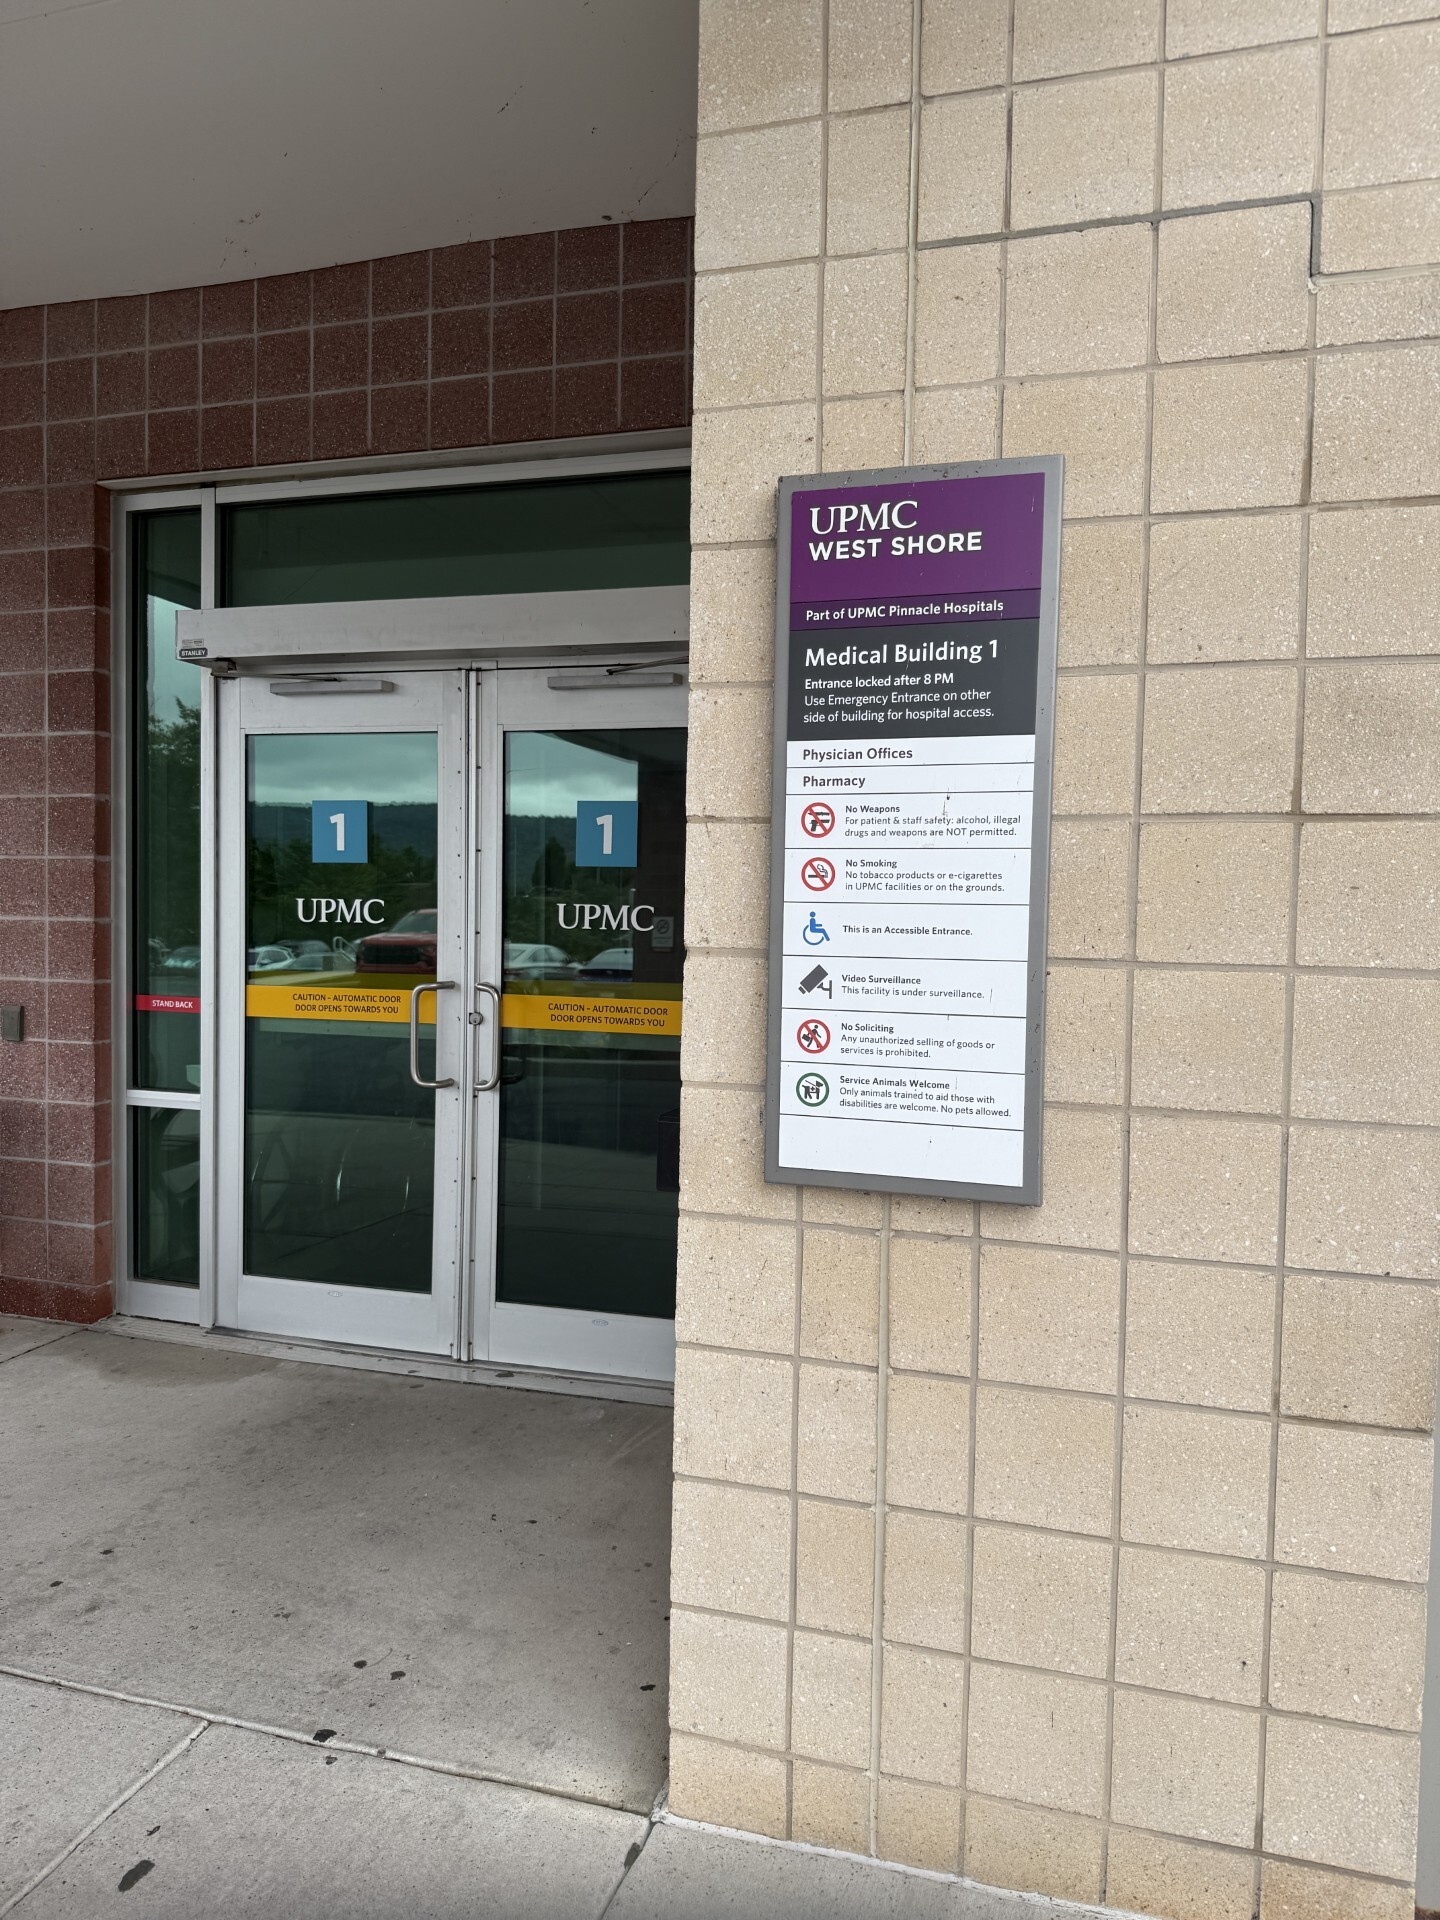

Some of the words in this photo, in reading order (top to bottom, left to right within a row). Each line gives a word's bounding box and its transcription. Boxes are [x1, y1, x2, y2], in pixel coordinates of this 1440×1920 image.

[810, 500, 917, 534] UPMC
[809, 538, 882, 561] WEST
[891, 531, 982, 555] SHORE
[806, 610, 830, 621] Part
[833, 608, 845, 619] of
[848, 606, 885, 619] UPMC
[889, 603, 941, 616] Pinnacle
[944, 600, 1003, 616] Hospitals
[805, 644, 887, 667] Medical
[895, 641, 983, 663] Building
[989, 639, 997, 658] 1
[805, 679, 853, 689] Entrance
[855, 675, 891, 687] locked
[894, 674, 921, 686] after
[924, 674, 931, 685] 8
[934, 673, 954, 684] PM
[805, 695, 825, 706] Use
[828, 694, 888, 707] Emergency
[891, 692, 940, 703] Entrance
[943, 692, 957, 701] on
[960, 688, 991, 700] other
[803, 711, 825, 723] side
[828, 710, 839, 722] of
[841, 710, 885, 723] building
[887, 709, 903, 720] for
[906, 707, 950, 721] hospital
[953, 708, 994, 718] access.
[803, 748, 863, 763] Physician
[867, 747, 913, 759] Offices
[803, 776, 866, 788] Pharmacy
[845, 805, 858, 813] No
[860, 805, 900, 814] Weapons
[845, 817, 858, 825] For
[860, 817, 891, 826] patient
[893, 816, 900, 824] &
[902, 816, 922, 824] staff
[924, 816, 954, 826] safety:
[956, 815, 991, 824] alcohol,
[993, 815, 1021, 825] illegal
[329, 813, 345, 851] 1
[596, 814, 612, 854] 1
[844, 829, 869, 838] drugs
[870, 828, 887, 837] and
[889, 830, 927, 838] weapons
[946, 827, 967, 836] NOT
[969, 827, 1017, 837] permitted.
[846, 859, 858, 867] No
[860, 859, 897, 869] Smoking
[845, 871, 858, 879] No
[860, 870, 894, 879] tobacco
[896, 871, 935, 880] products
[948, 872, 1003, 881] e-cigarettes
[845, 882, 853, 890] in
[855, 882, 882, 891] UPMC
[885, 882, 922, 891] facilities
[949, 883, 963, 891] the
[965, 883, 1005, 893] grounds.
[296, 898, 384, 924] UPMC
[557, 903, 654, 931] UPMC
[842, 925, 860, 933] This
[862, 925, 870, 933] is
[884, 926, 930, 935] Accessible
[932, 927, 973, 935] Entrance.
[841, 974, 866, 983] Video
[868, 975, 921, 984] Surveillance
[292, 993, 326, 1001] CAUTION
[332, 994, 377, 1003] AUTOMATIC
[379, 995, 401, 1003] DOOR
[841, 985, 859, 994] This
[861, 986, 890, 997] facility
[892, 988, 900, 996] is
[902, 988, 927, 997] under
[929, 989, 984, 999] surveillance.
[152, 1000, 175, 1008] STAND
[295, 1004, 317, 1012] DOOR
[318, 1004, 342, 1012] OPENS
[343, 1005, 381, 1013] TOWARDS
[382, 1006, 399, 1014] YOU
[548, 1003, 585, 1012] CAUTION
[592, 1005, 641, 1015] AUTOMATIC
[643, 1007, 668, 1016] DOOR
[550, 1014, 574, 1022] DOOR
[576, 1015, 602, 1024] OPENS
[604, 1016, 645, 1026] TOWARDS
[647, 1019, 665, 1027] YOU
[841, 1023, 853, 1031] No
[855, 1023, 894, 1034] Soliciting
[841, 1034, 857, 1044] Any
[859, 1036, 914, 1045] unauthorized
[916, 1038, 944, 1048] selling
[946, 1039, 955, 1047] of
[956, 1040, 984, 1049] goods
[840, 1047, 874, 1055] services
[876, 1047, 883, 1056] is
[885, 1048, 931, 1058] prohibited.
[840, 1075, 870, 1085] Service
[872, 1077, 907, 1087] Animals
[909, 1079, 950, 1089] Welcome
[839, 1087, 859, 1097] Only
[860, 1089, 892, 1098] animals
[894, 1089, 923, 1100] trained
[936, 1093, 949, 1101] aid
[951, 1094, 974, 1103] those
[976, 1096, 995, 1104] with
[839, 1098, 882, 1109] disabilities
[884, 1101, 898, 1110] are
[899, 1102, 938, 1112] welcome.
[941, 1105, 953, 1113] No
[955, 1107, 974, 1115] pets
[975, 1107, 1011, 1117] allowed.
